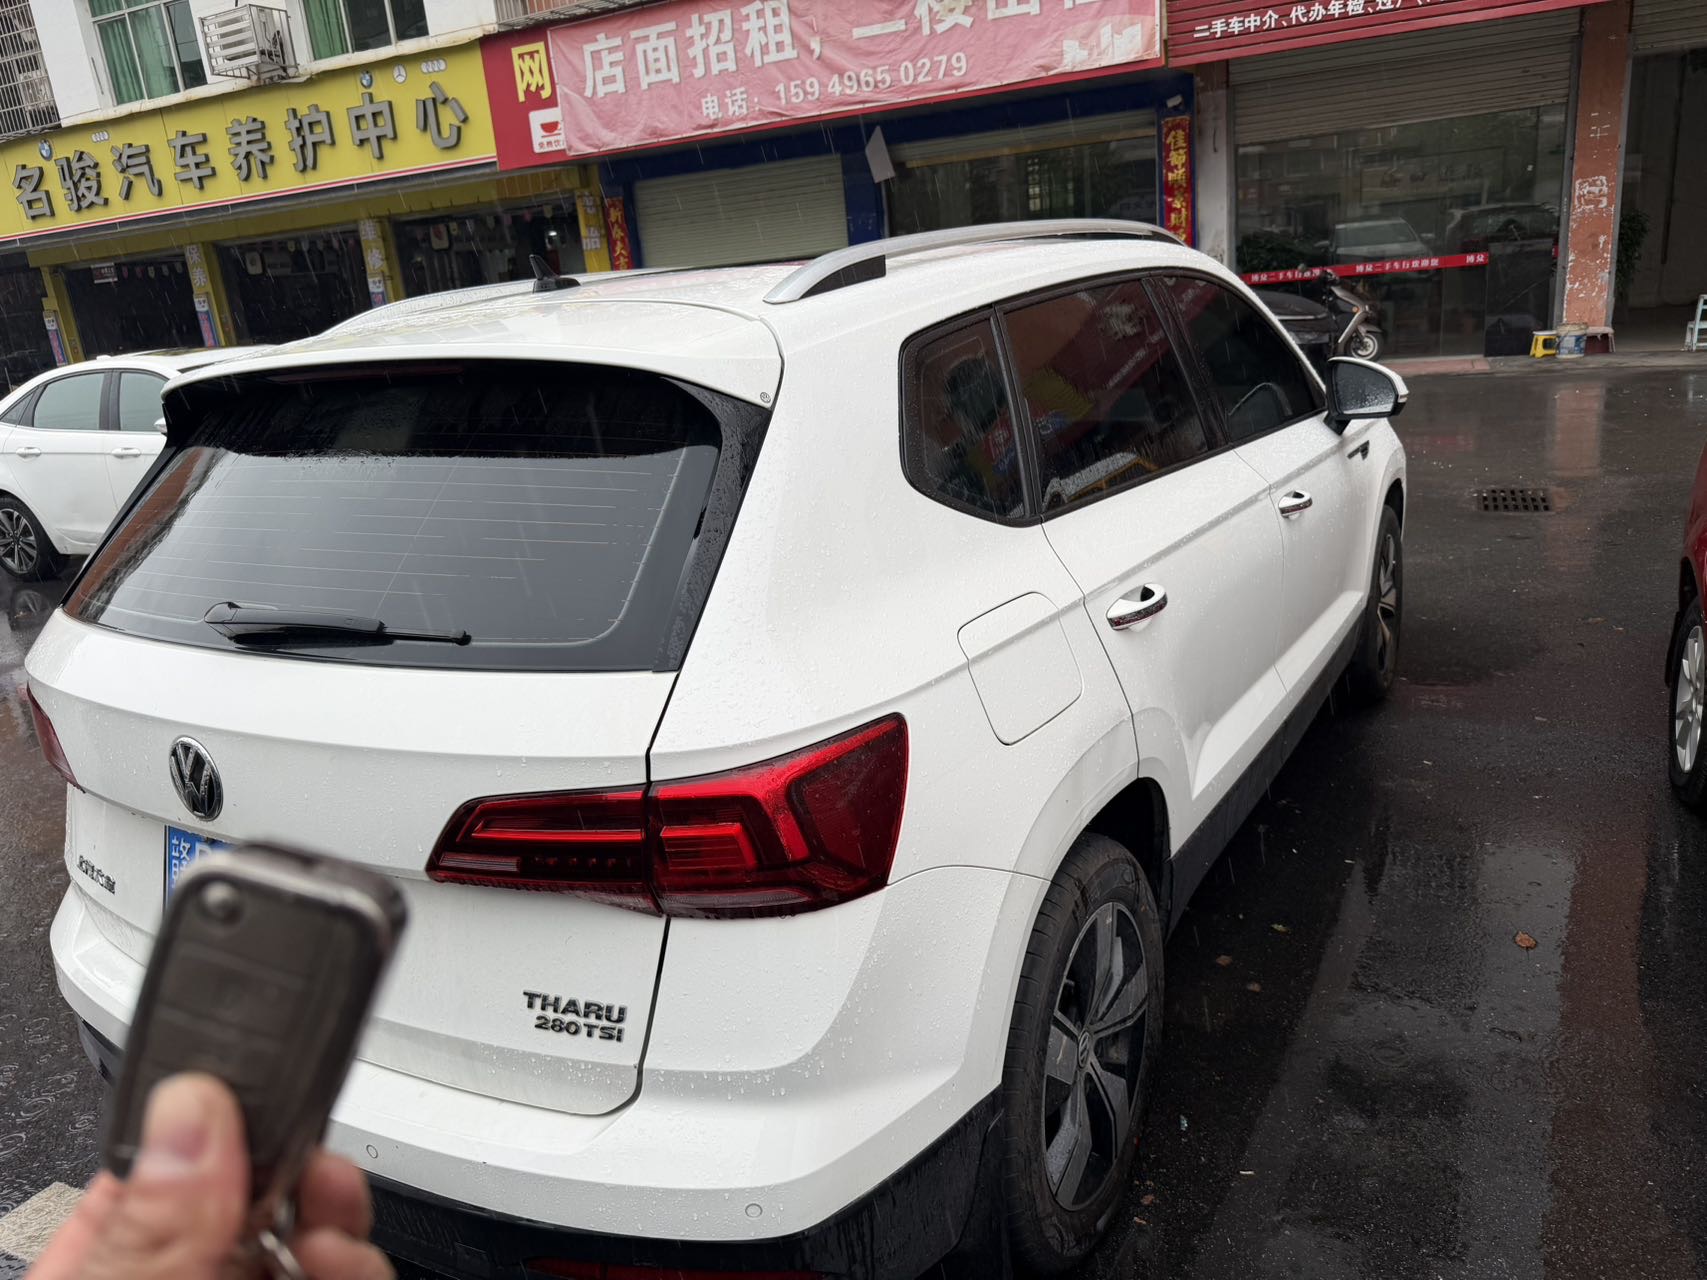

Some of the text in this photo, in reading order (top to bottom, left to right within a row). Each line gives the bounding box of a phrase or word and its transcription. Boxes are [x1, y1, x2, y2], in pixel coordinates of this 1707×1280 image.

[511, 41, 552, 103] 网
[775, 79, 820, 107] 159
[827, 64, 892, 98] 4965
[900, 52, 968, 85] 0279
[12, 81, 469, 220] 名骏汽车养护中心
[522, 989, 628, 1024] THARU
[534, 1014, 626, 1043] 280TSI
